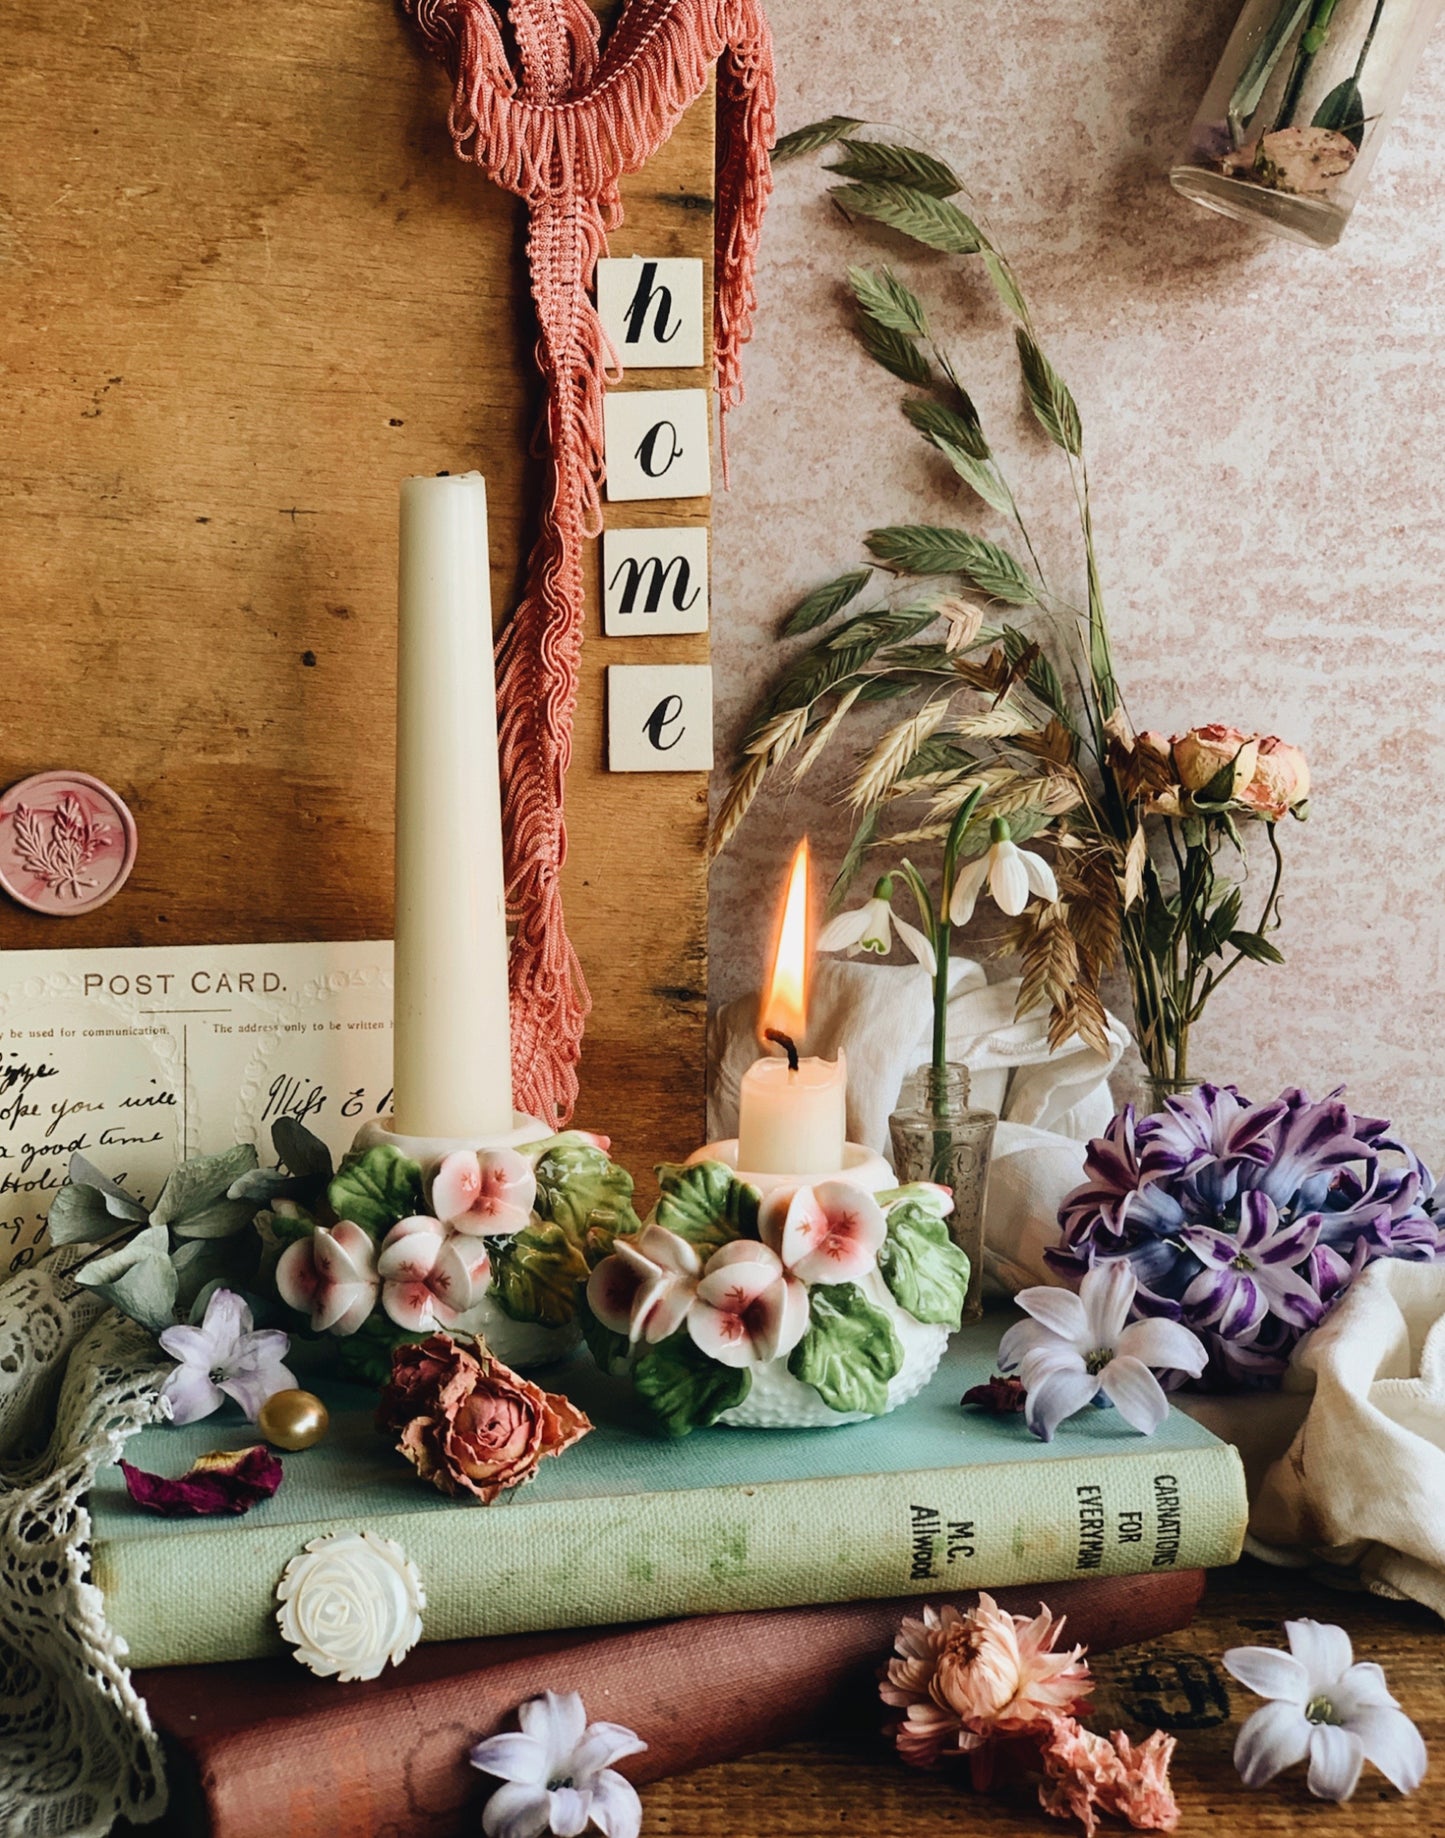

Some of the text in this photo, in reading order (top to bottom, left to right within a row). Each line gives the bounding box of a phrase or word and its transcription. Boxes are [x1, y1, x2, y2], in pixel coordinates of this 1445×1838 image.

[84, 971, 288, 996] POST CARD.
[10, 1028, 23, 1039] be
[29, 1027, 54, 1038] used
[60, 1027, 76, 1038] for
[82, 1025, 171, 1037] communication.
[213, 1023, 233, 1034] The
[238, 1022, 279, 1033] address
[284, 1021, 307, 1035] only
[312, 1022, 324, 1031] to
[329, 1020, 342, 1031] be
[347, 1019, 385, 1030] written
[0, 1078, 178, 1137] ope you will
[21, 1133, 92, 1174] good
[99, 1126, 164, 1146] time
[910, 1504, 941, 1580] Allwood
[947, 1521, 974, 1564] M.C.
[1076, 1485, 1104, 1570] EVERYMAN
[1118, 1511, 1142, 1544] FOR
[1152, 1474, 1181, 1567] CARNATIONS
